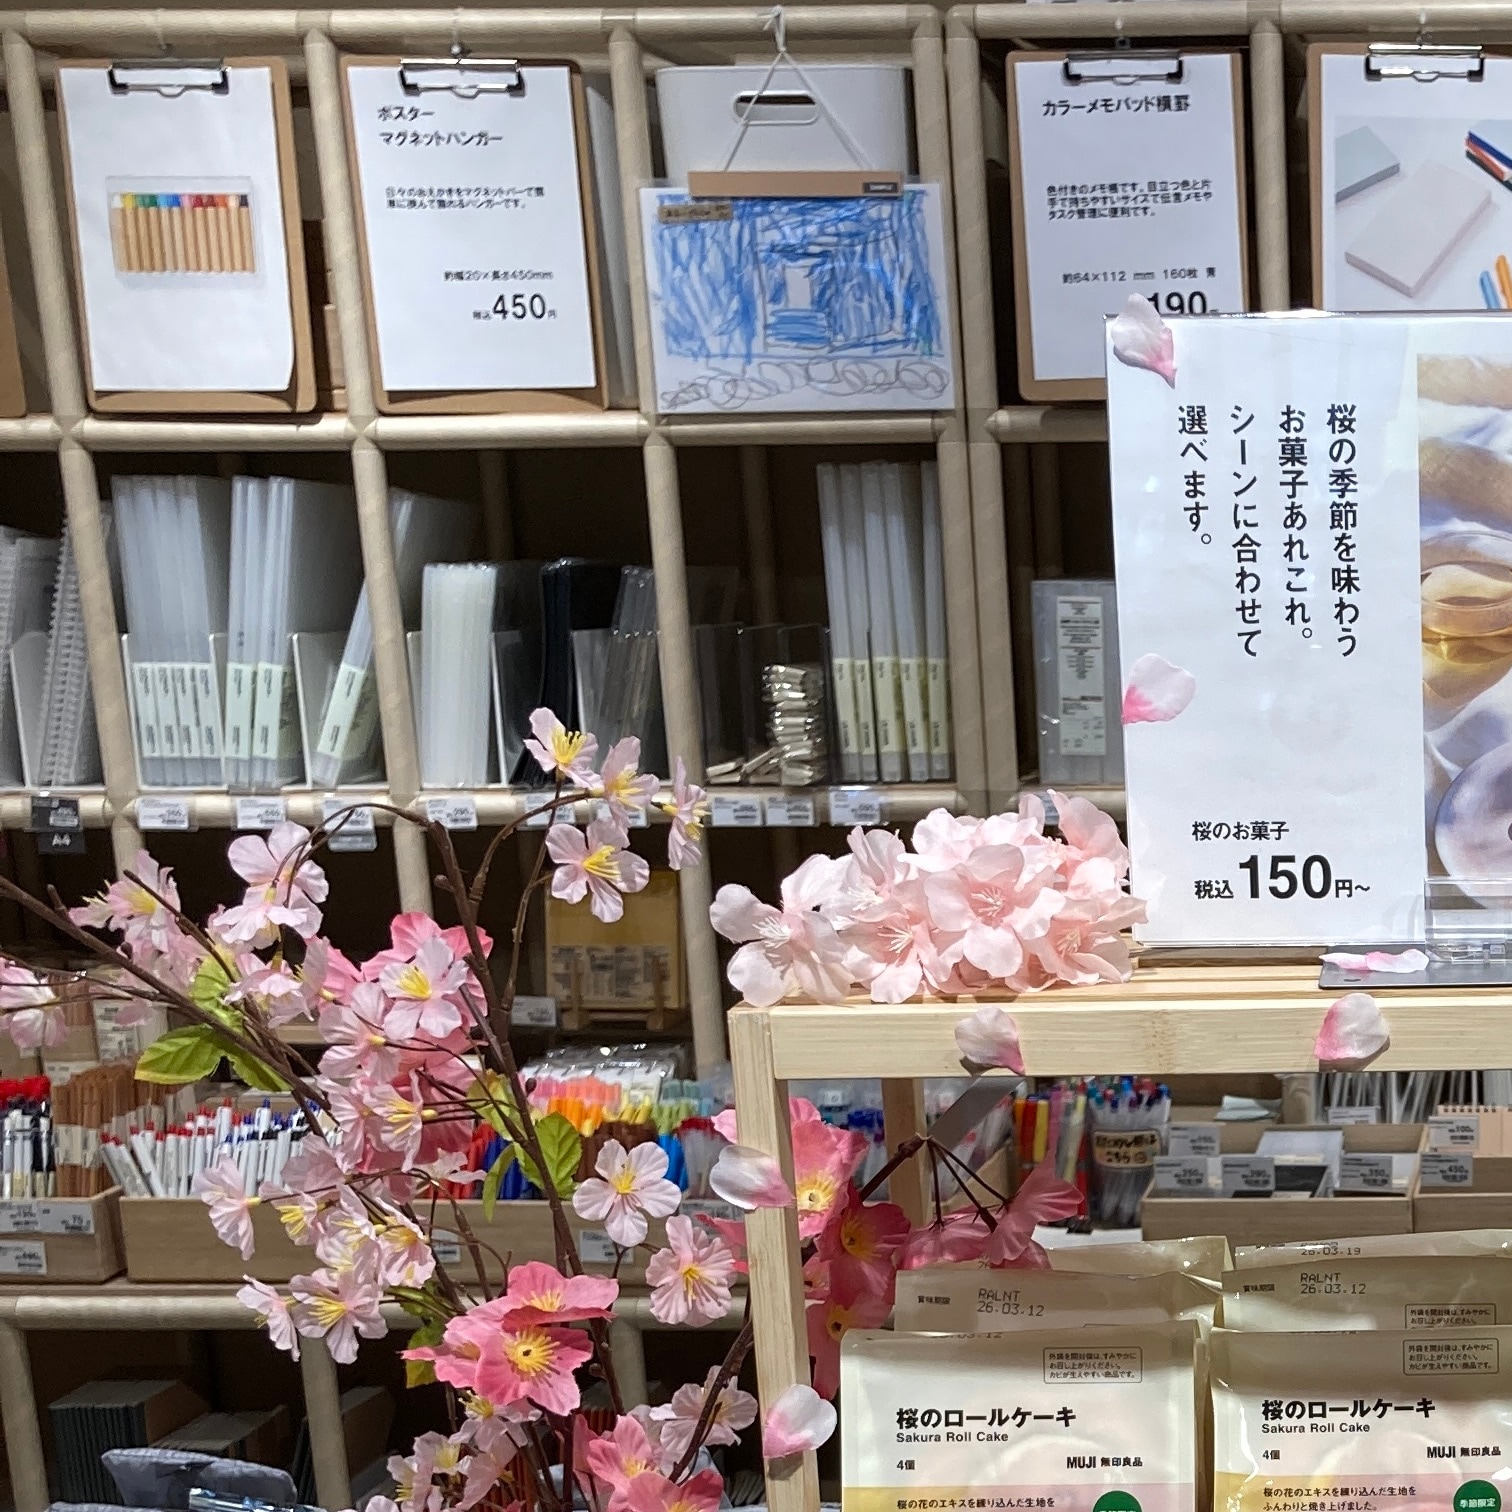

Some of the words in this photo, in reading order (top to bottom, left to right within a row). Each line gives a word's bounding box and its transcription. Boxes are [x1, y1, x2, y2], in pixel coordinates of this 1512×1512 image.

[377, 105, 435, 121] ポスター
[379, 130, 503, 146] マグネットハンガー
[1177, 404, 1213, 546] 選べます。
[1229, 404, 1262, 658] シーンに合わせて
[1277, 403, 1314, 642] お菓子あれこれ。
[1326, 403, 1361, 658] 桜の季節を味わう
[1191, 820, 1290, 842] 桜のお菓子
[1194, 878, 1235, 900] 税込
[896, 1407, 1077, 1430] 桜のロールケーキ
[1261, 1398, 1436, 1421] 桜のロールケーキ
[896, 1432, 942, 1443] Sakura
[946, 1431, 972, 1443] Roll
[976, 1431, 1009, 1443] Cake
[1261, 1423, 1305, 1434] Sakura
[1310, 1423, 1335, 1434] Roll
[1339, 1422, 1370, 1434] Cake
[1427, 1446, 1456, 1459] MUJI
[1460, 1446, 1502, 1457] 無印良品
